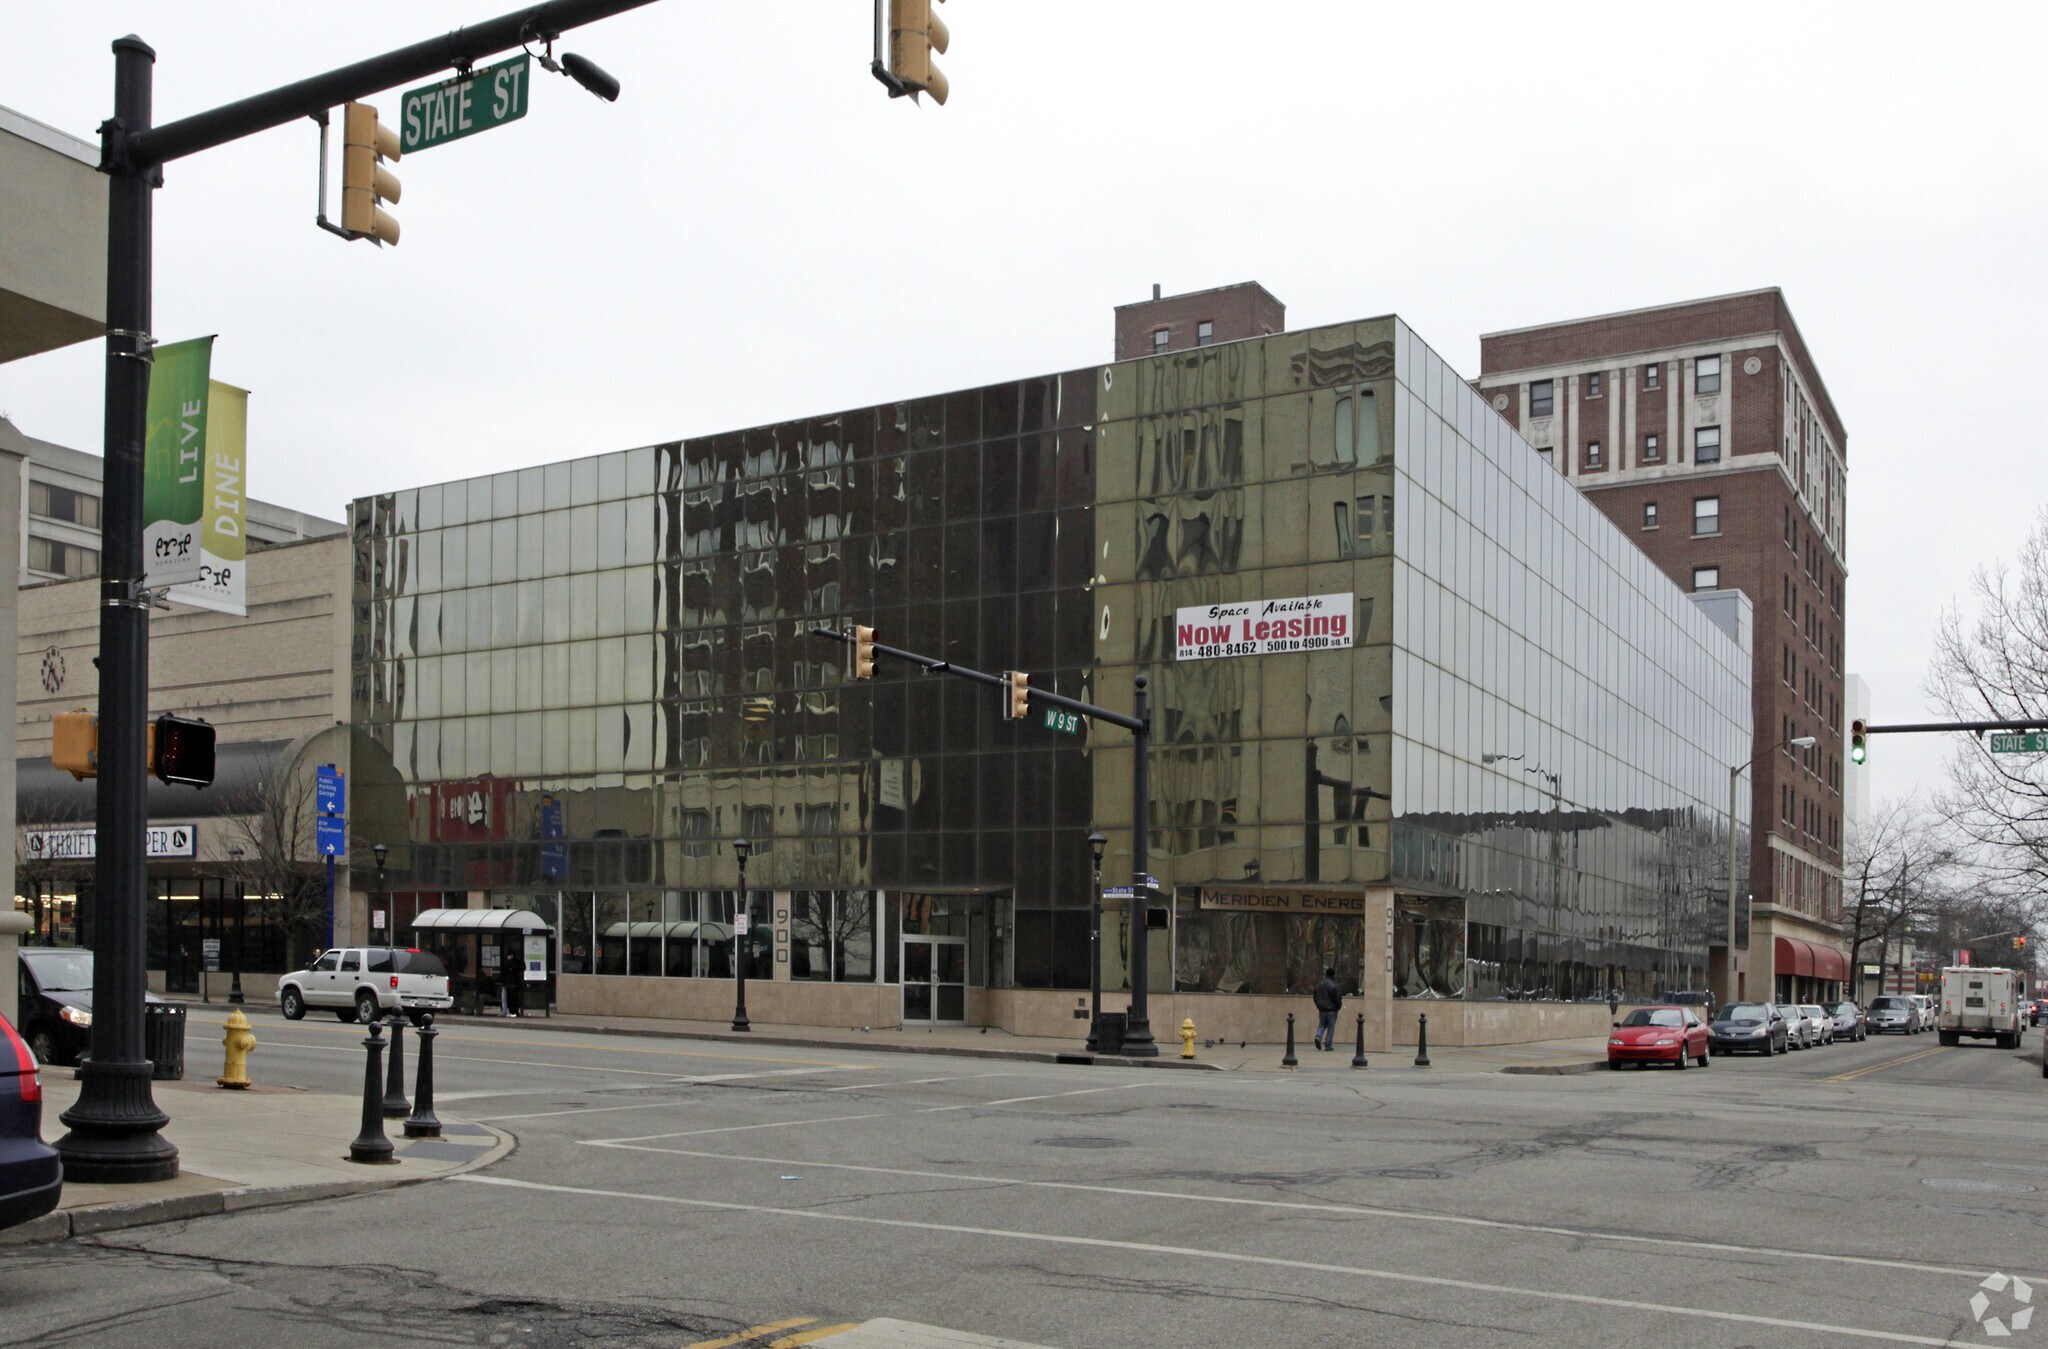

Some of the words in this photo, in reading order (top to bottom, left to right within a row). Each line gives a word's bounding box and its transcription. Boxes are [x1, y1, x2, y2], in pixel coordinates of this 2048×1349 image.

[405, 81, 473, 147] STATE
[493, 63, 524, 120] ST
[179, 399, 200, 484] LIVE
[215, 452, 240, 537] DINE
[155, 532, 192, 557] erie
[1208, 606, 1249, 620] Space
[1262, 599, 1323, 616] Available
[1178, 624, 1231, 647] Now
[1243, 613, 1347, 642] Leasing
[1267, 640, 1287, 652] 500
[1290, 639, 1300, 650] to
[1302, 636, 1329, 649] 4900
[1047, 710, 1057, 727] W
[1058, 713, 1065, 729] 9
[1066, 715, 1078, 732] ST
[1993, 734, 2026, 752] STATE
[319, 784, 337, 792] Parking
[319, 790, 336, 798] Garage
[1203, 891, 1289, 907] MERIDIEN
[1302, 894, 1366, 910] ENERG
